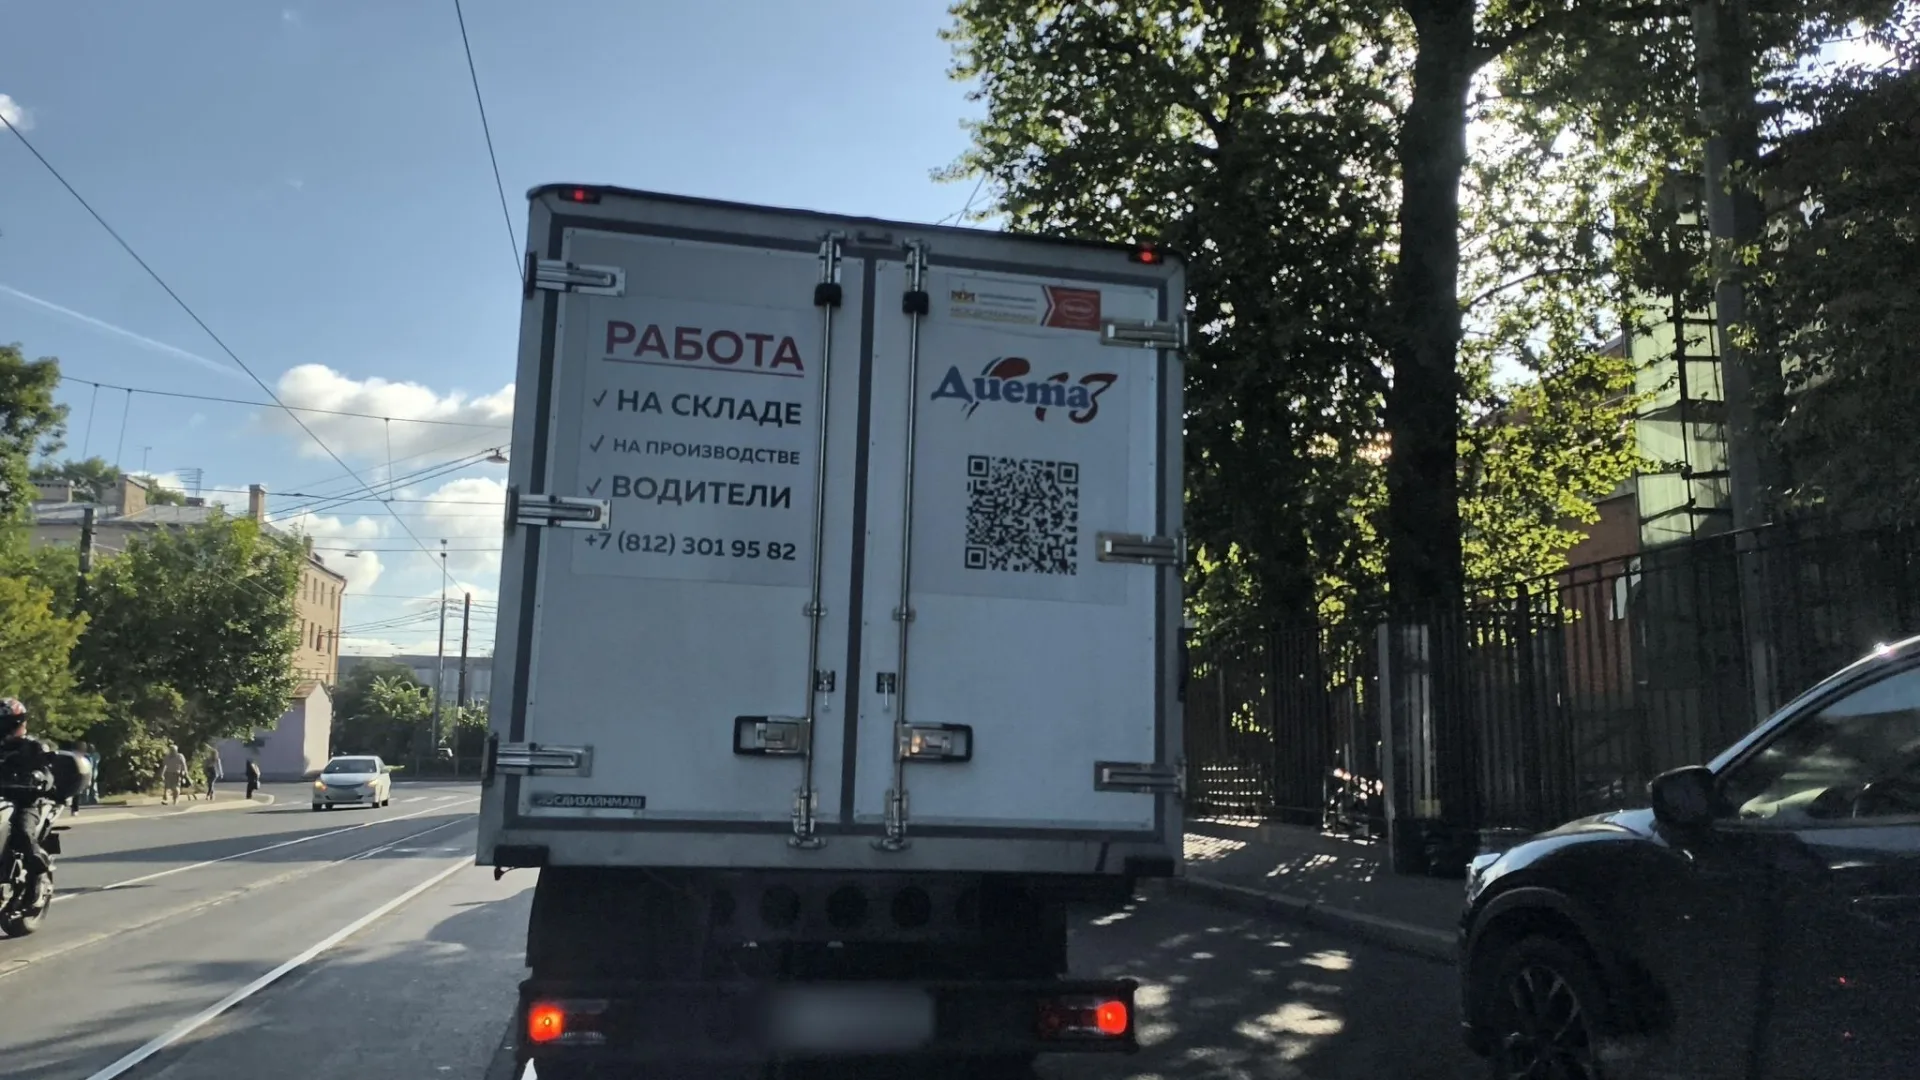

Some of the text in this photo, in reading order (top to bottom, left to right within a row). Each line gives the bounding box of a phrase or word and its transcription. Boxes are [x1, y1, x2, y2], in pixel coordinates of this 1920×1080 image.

[605, 320, 805, 371] РАБОТА
[931, 366, 1090, 409] Диета
[616, 388, 802, 428] НА СКЛАДЕ
[612, 437, 800, 465] НА ПРОИЗВОДСТВЕ
[611, 475, 791, 509] ВОДИТЕЛИ
[584, 530, 797, 561] +7 (812) 301 95 82
